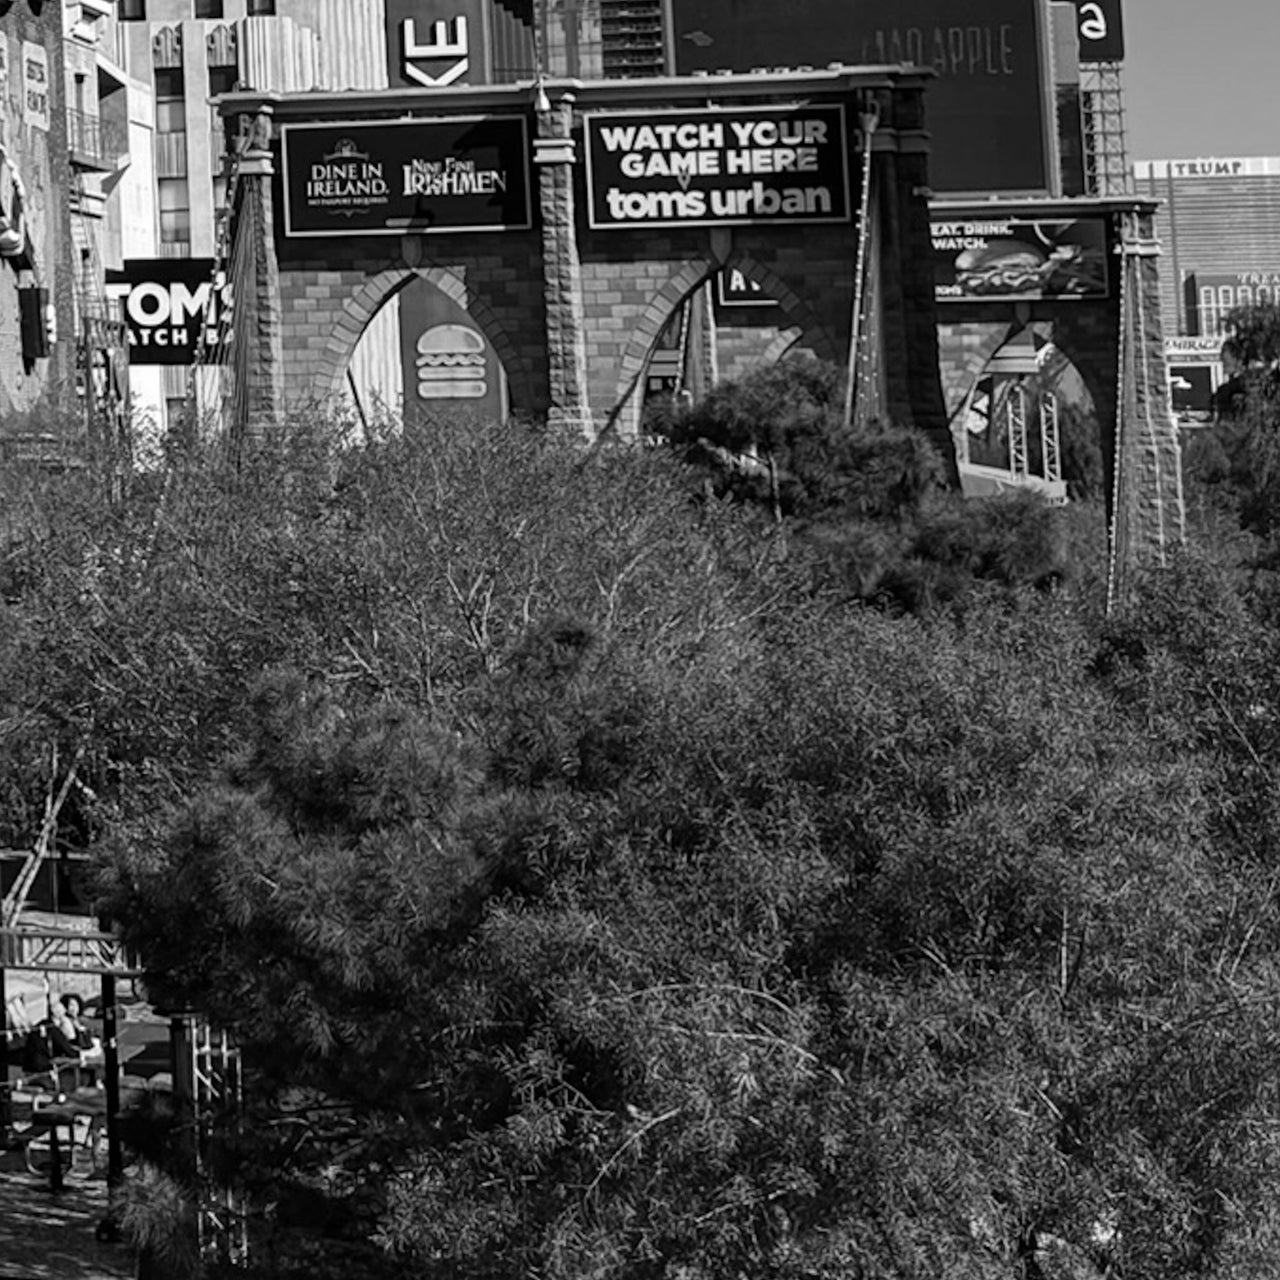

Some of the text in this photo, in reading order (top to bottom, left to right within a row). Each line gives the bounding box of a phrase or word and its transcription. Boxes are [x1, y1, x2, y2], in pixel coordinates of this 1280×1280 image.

[600, 120, 828, 152] WATCH YOUR
[311, 162, 383, 181] DINE IN
[620, 147, 818, 178] GAME HERE
[1174, 161, 1242, 175] TRUMP
[307, 179, 389, 197] IRELAND.
[402, 164, 507, 197] IRISHMEN
[606, 181, 831, 219] toms urban
[930, 223, 1014, 236] EAT. DRINK.
[931, 237, 989, 250] WATCH.
